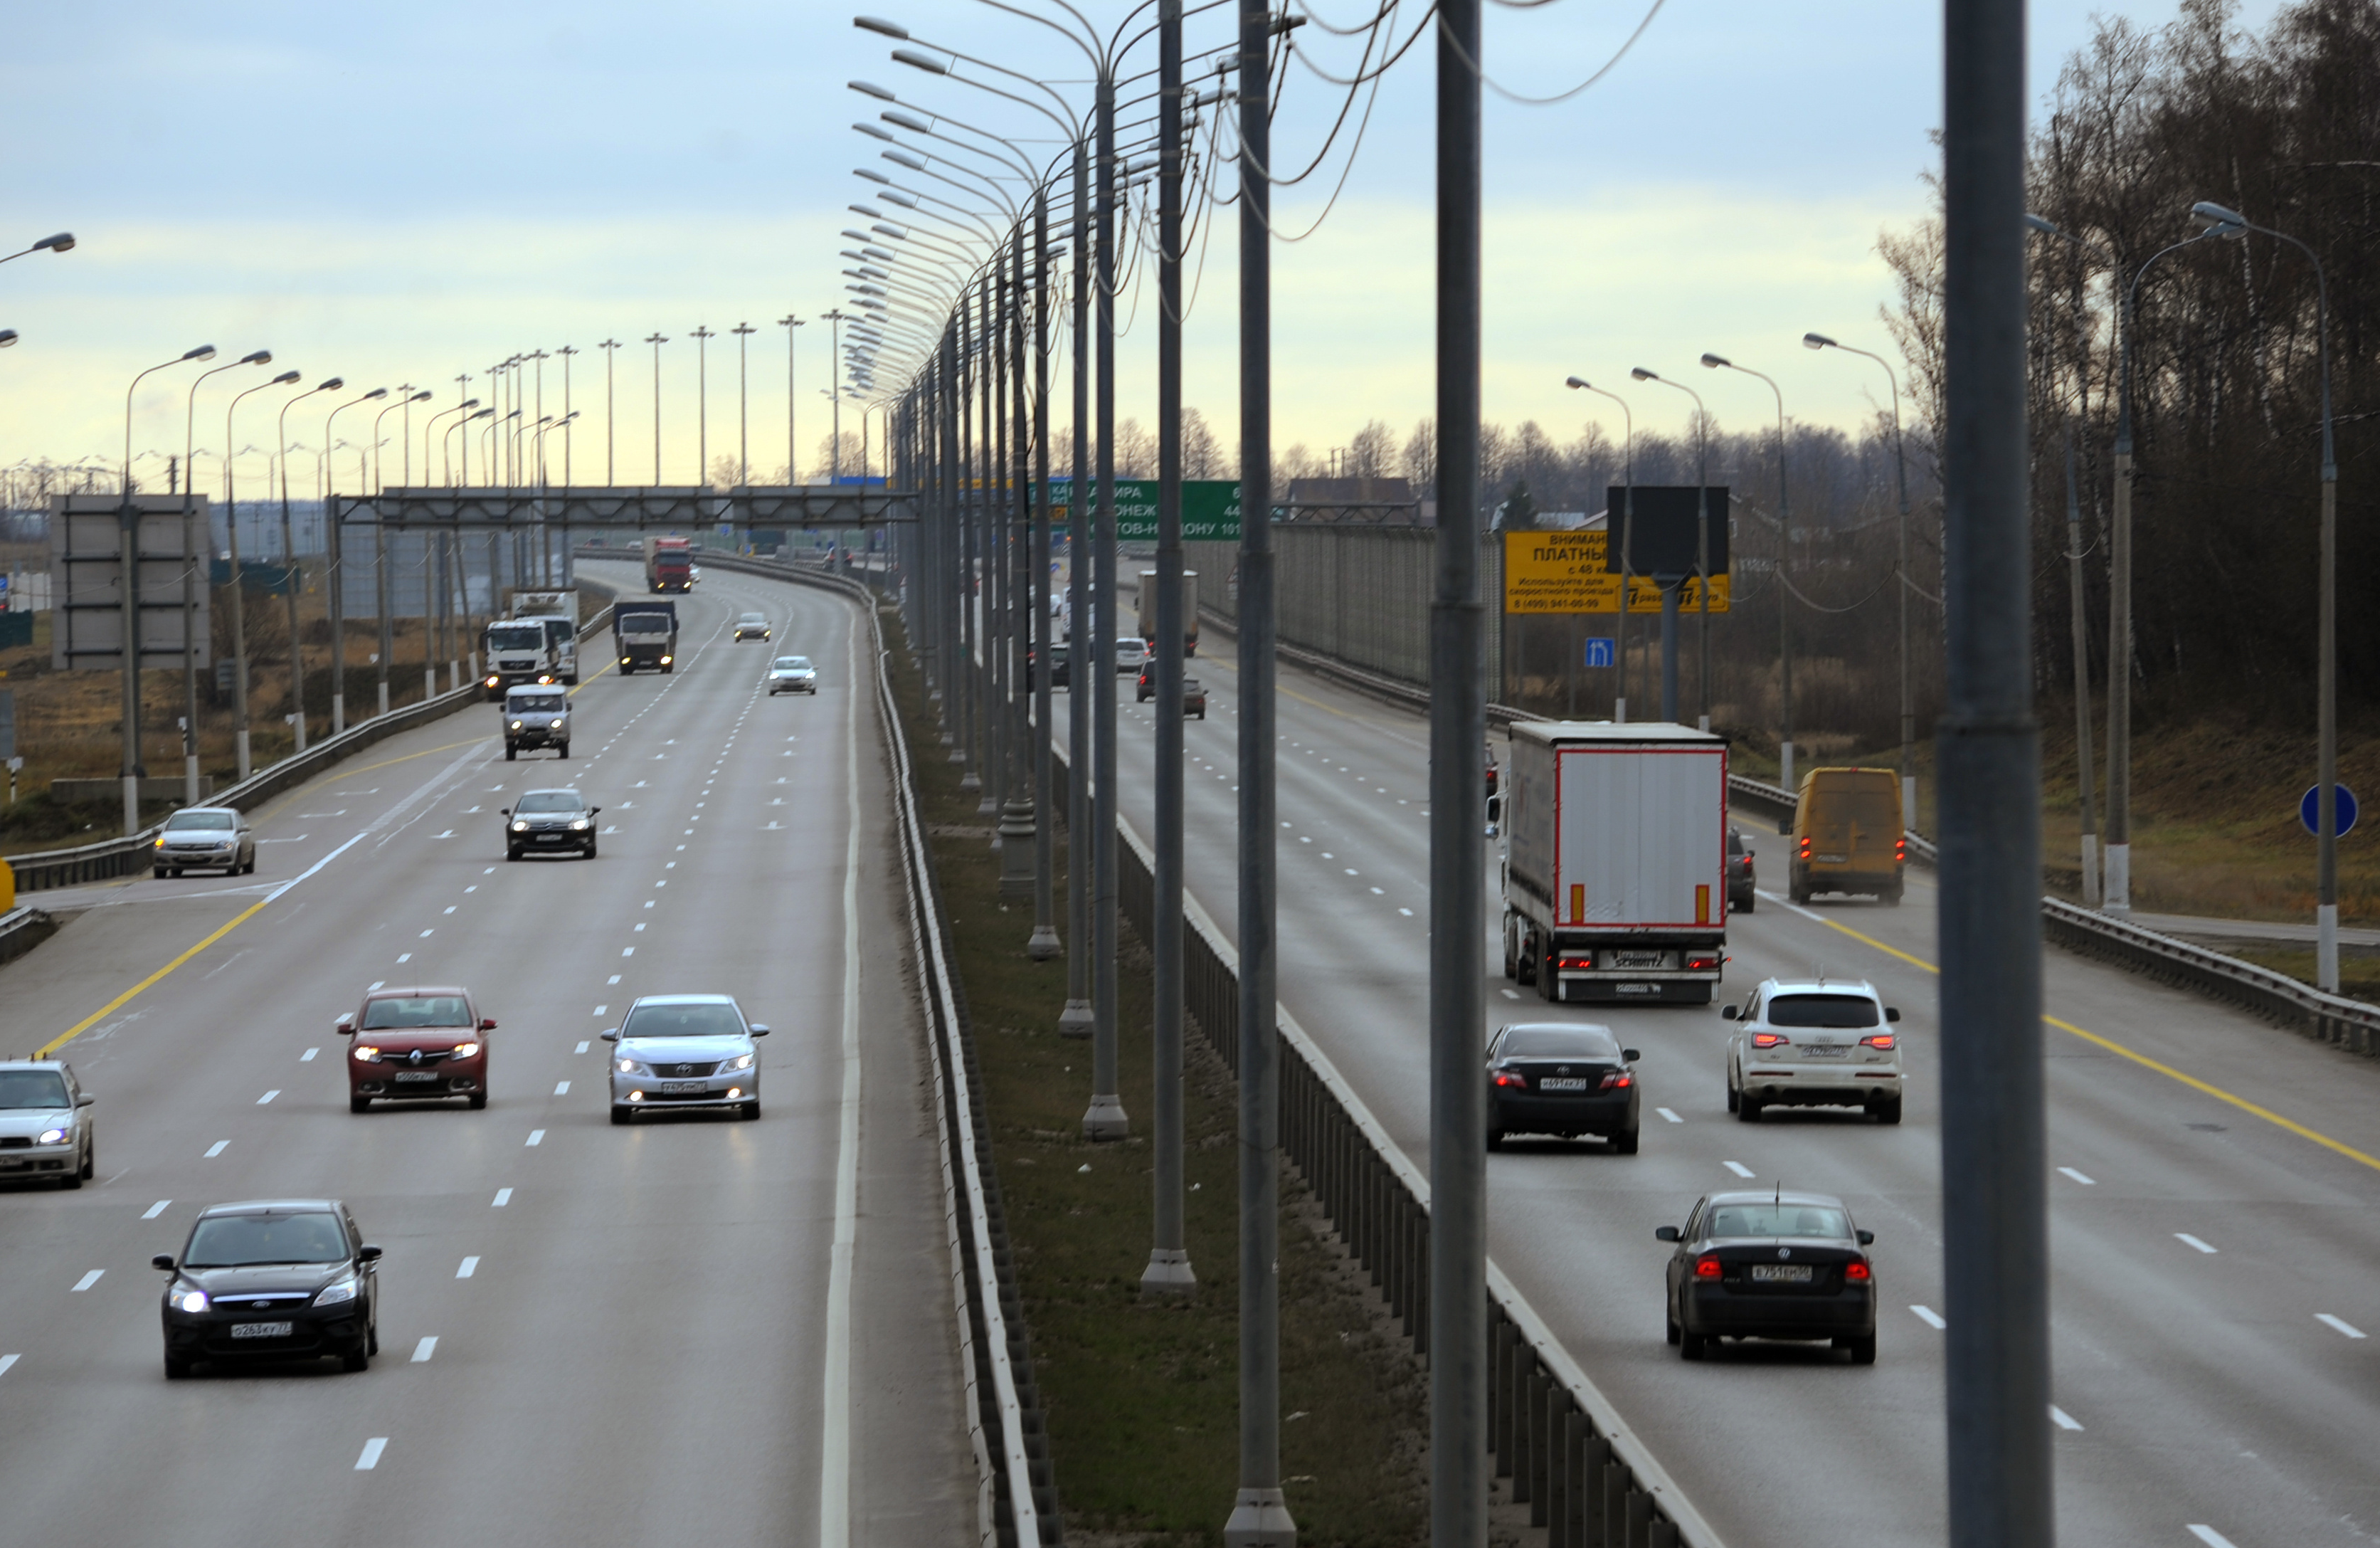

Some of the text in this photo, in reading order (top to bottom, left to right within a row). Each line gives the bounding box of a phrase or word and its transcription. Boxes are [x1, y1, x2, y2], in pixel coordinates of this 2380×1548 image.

[1550, 535, 1607, 545] ВНИМАН
[1533, 547, 1607, 562] ПЛАТНЫ
[1615, 958, 1664, 968] SCHMITZ
